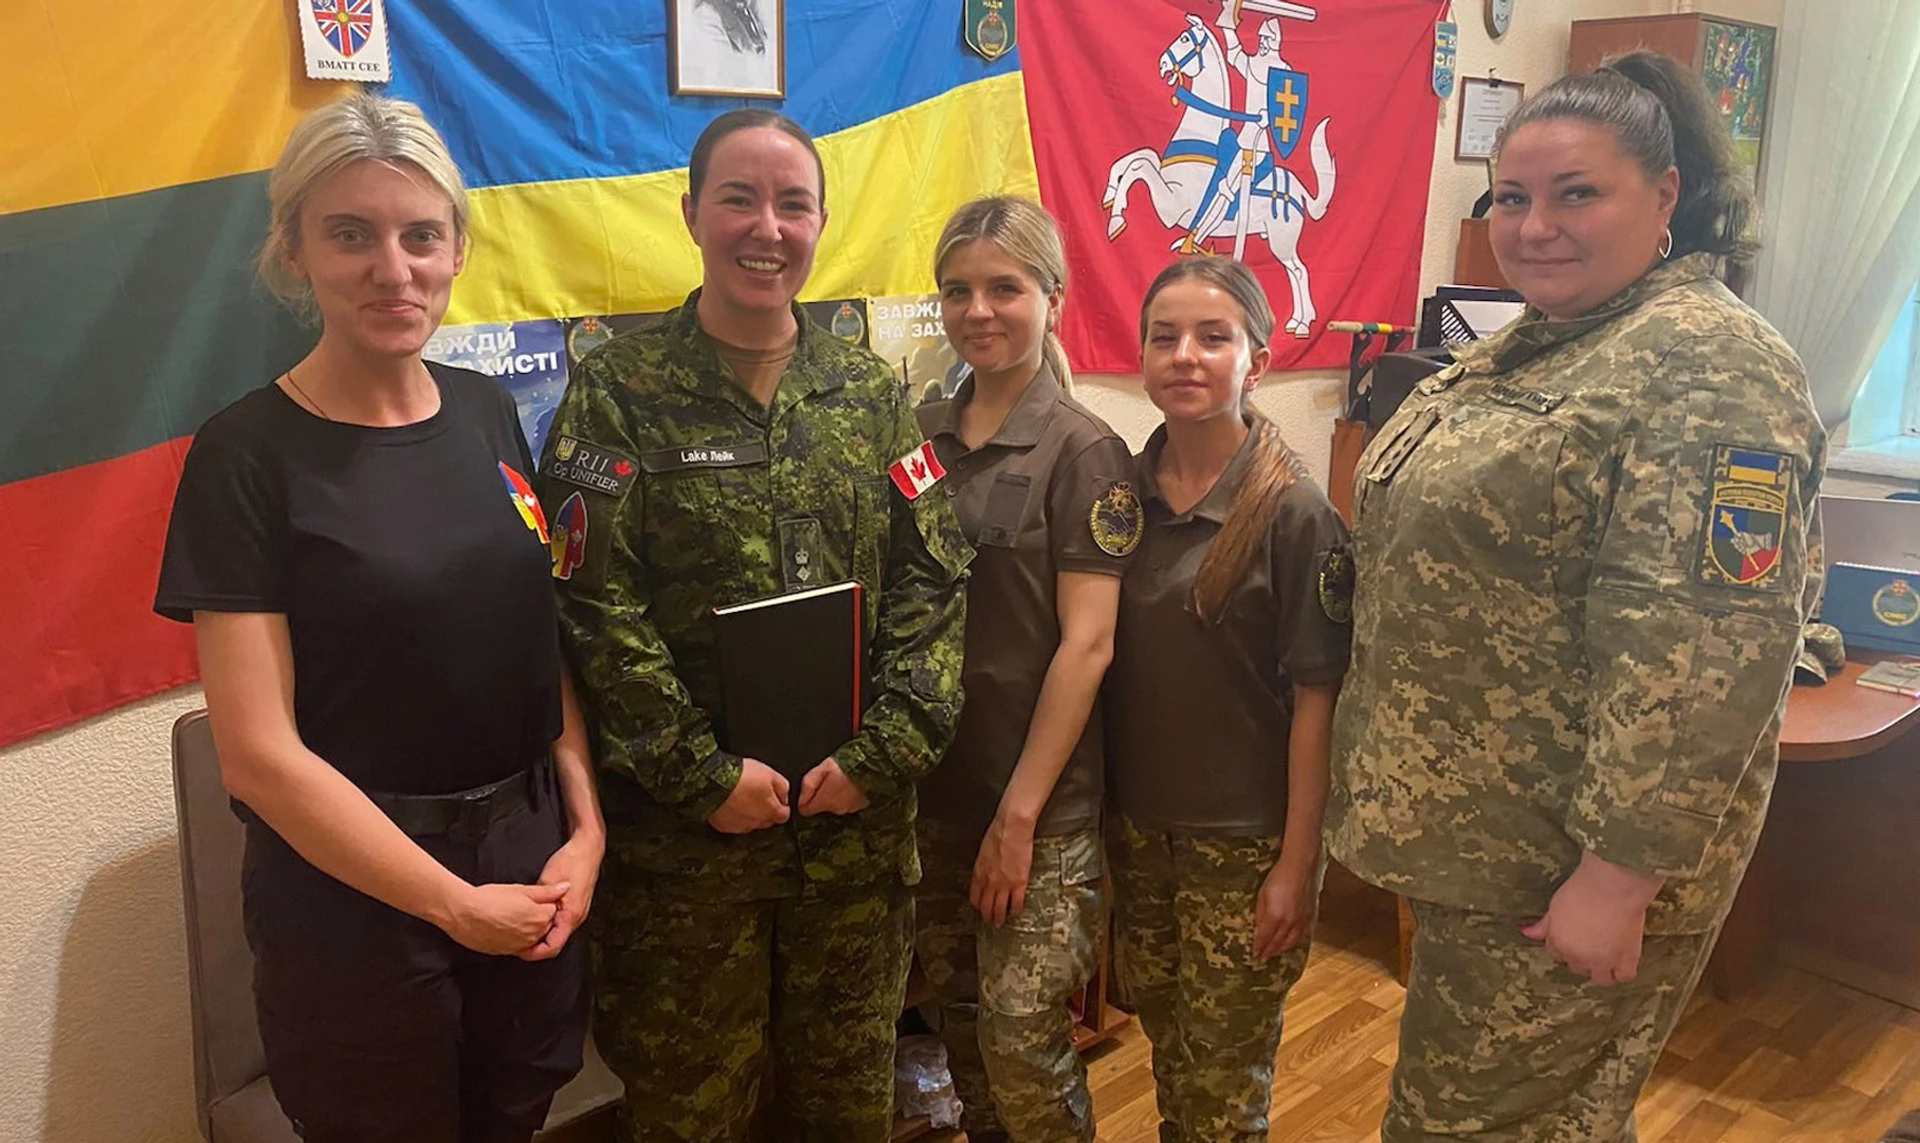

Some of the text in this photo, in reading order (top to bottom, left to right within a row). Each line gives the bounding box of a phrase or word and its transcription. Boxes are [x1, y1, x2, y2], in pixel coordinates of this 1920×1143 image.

[317, 60, 381, 72] BMATT CEE
[877, 324, 904, 342] НА
[680, 450, 708, 462] Lake
[553, 462, 619, 492] Op UNIFIER
